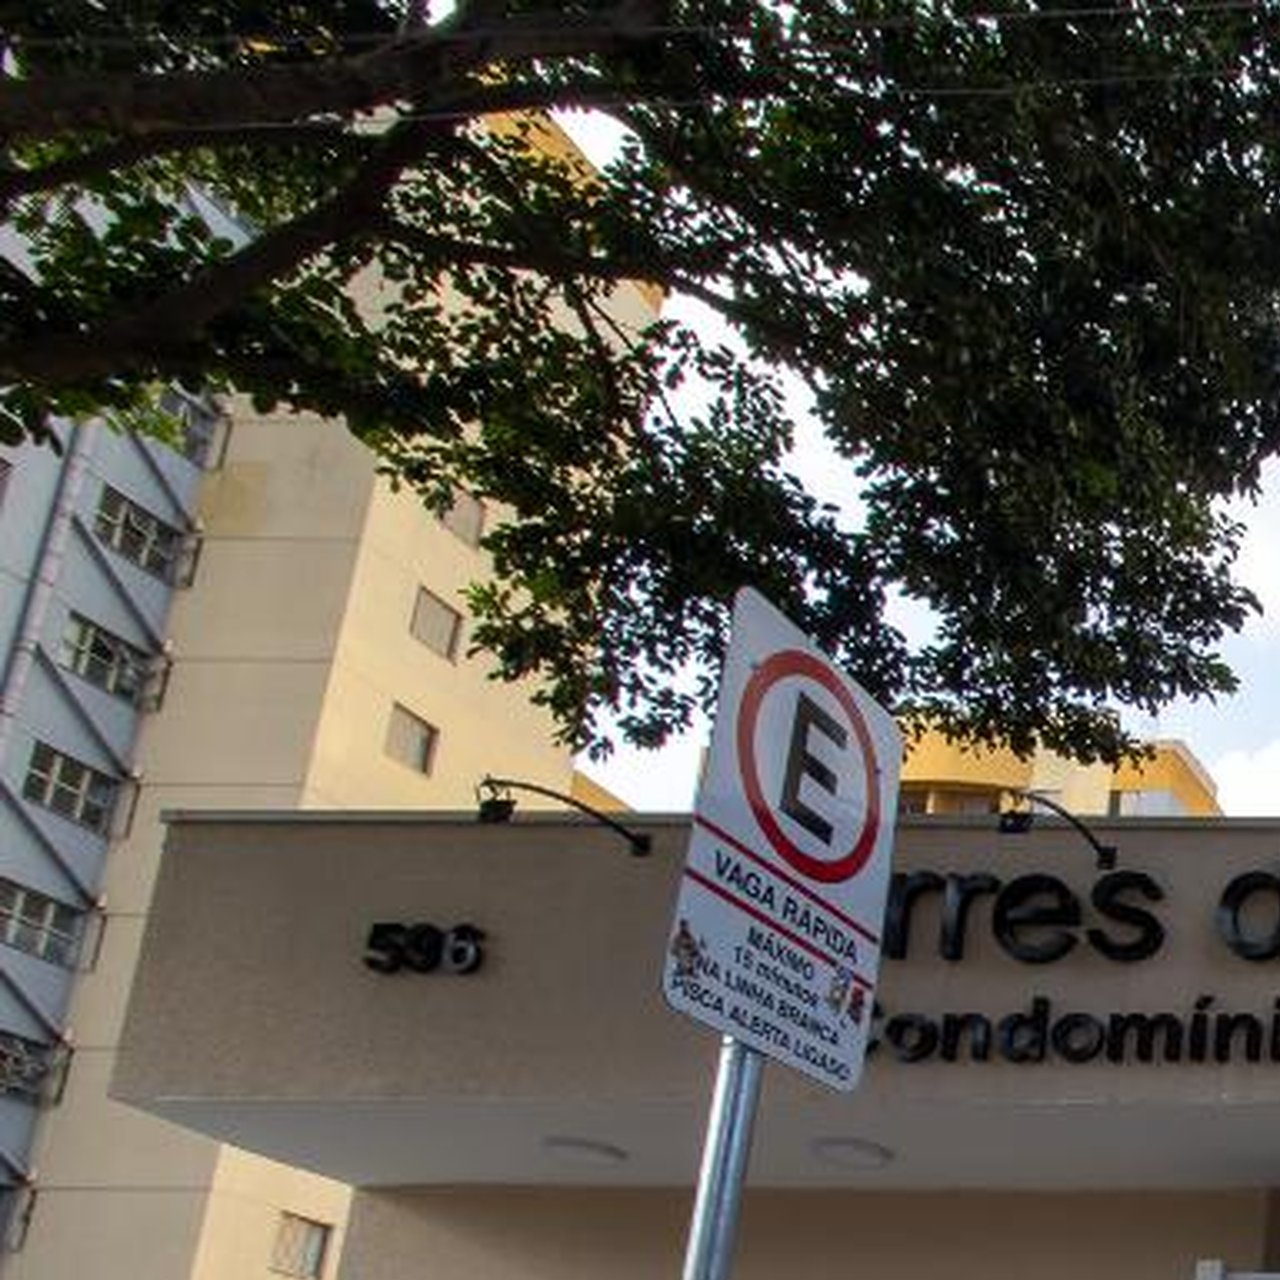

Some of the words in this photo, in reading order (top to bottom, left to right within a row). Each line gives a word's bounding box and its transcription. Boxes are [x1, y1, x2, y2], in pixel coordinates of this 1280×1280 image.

[778, 691, 848, 846] E
[714, 850, 776, 912] VAGA
[884, 869, 1166, 964] rres
[729, 1005, 791, 1048] ALERTA
